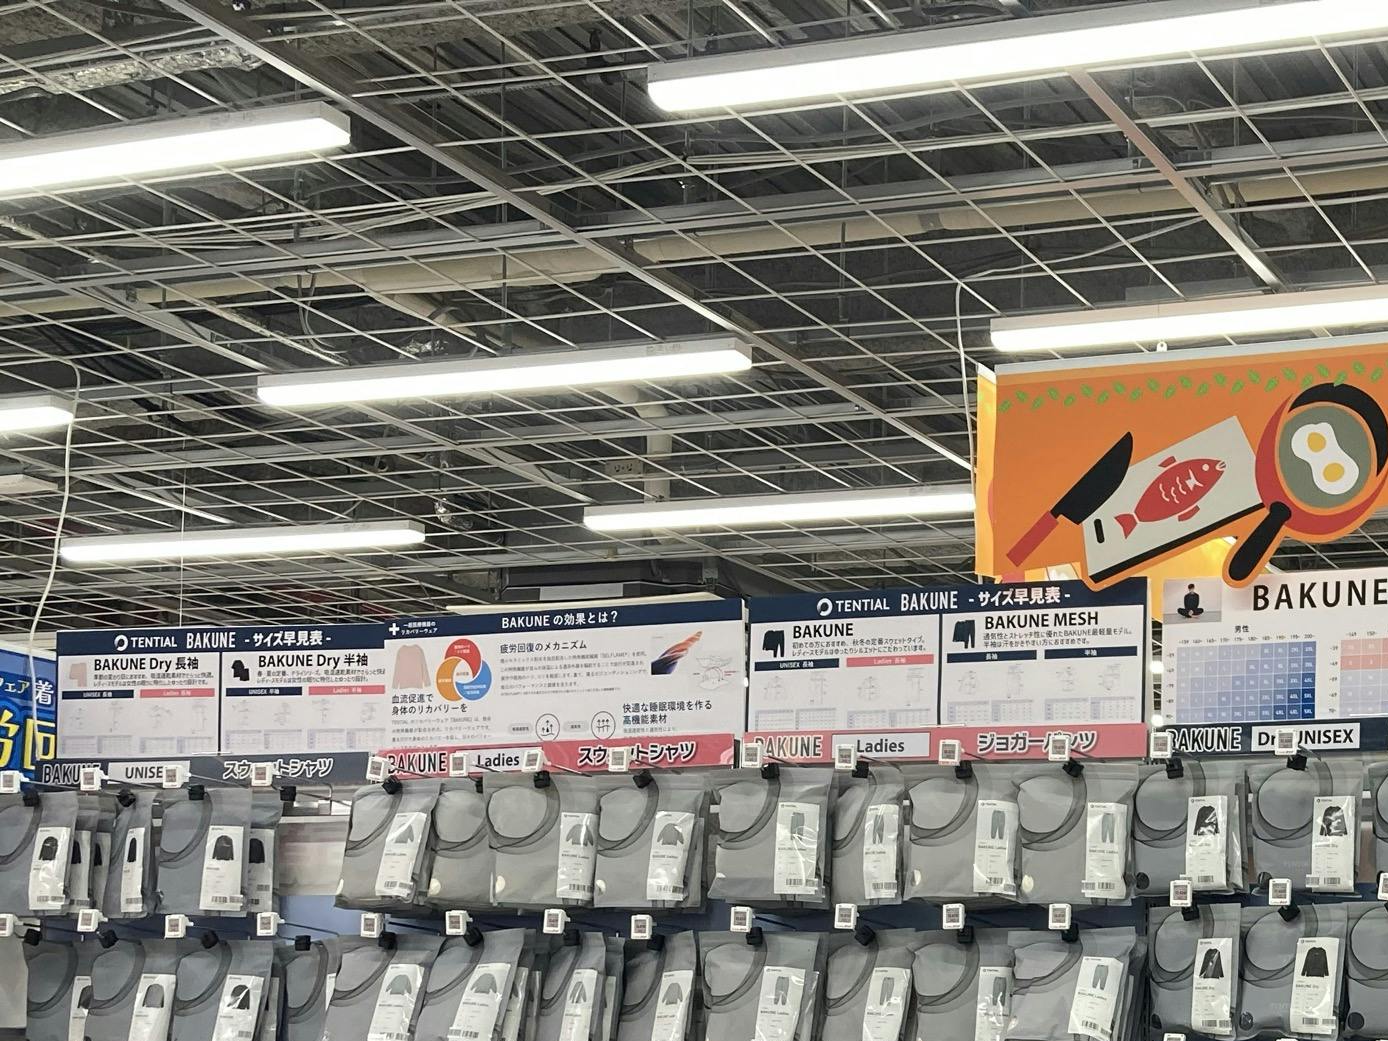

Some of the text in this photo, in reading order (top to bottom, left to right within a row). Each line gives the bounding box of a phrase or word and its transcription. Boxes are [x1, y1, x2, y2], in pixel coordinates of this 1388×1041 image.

[835, 597, 890, 613] TENTIAL
[900, 591, 958, 612] BAKUNE
[1252, 578, 1388, 611] BAKUNE
[501, 611, 619, 630] BAKUNE の効果とは？
[985, 611, 1099, 630] BAKUNE MESH
[130, 634, 178, 649] TENTIAL
[186, 632, 237, 649] BAKUNE
[793, 622, 854, 640] BAKUNE
[499, 640, 587, 655] 疲労回復のメカニズム
[94, 656, 199, 674] BAKUNE Dry 長袖
[258, 652, 369, 672] BAKUNE Dry 半袖
[35, 680, 54, 705] 着
[391, 693, 434, 705] 血流促進で
[391, 703, 468, 715] 身体のリカバリーを
[856, 738, 905, 755] Ladies
[977, 731, 1098, 753] ジョガーツ
[125, 766, 165, 780] UNISE
[223, 757, 334, 780] スウトシャツ
[386, 741, 696, 777] BAKUNE Ladies スウトシャツ
